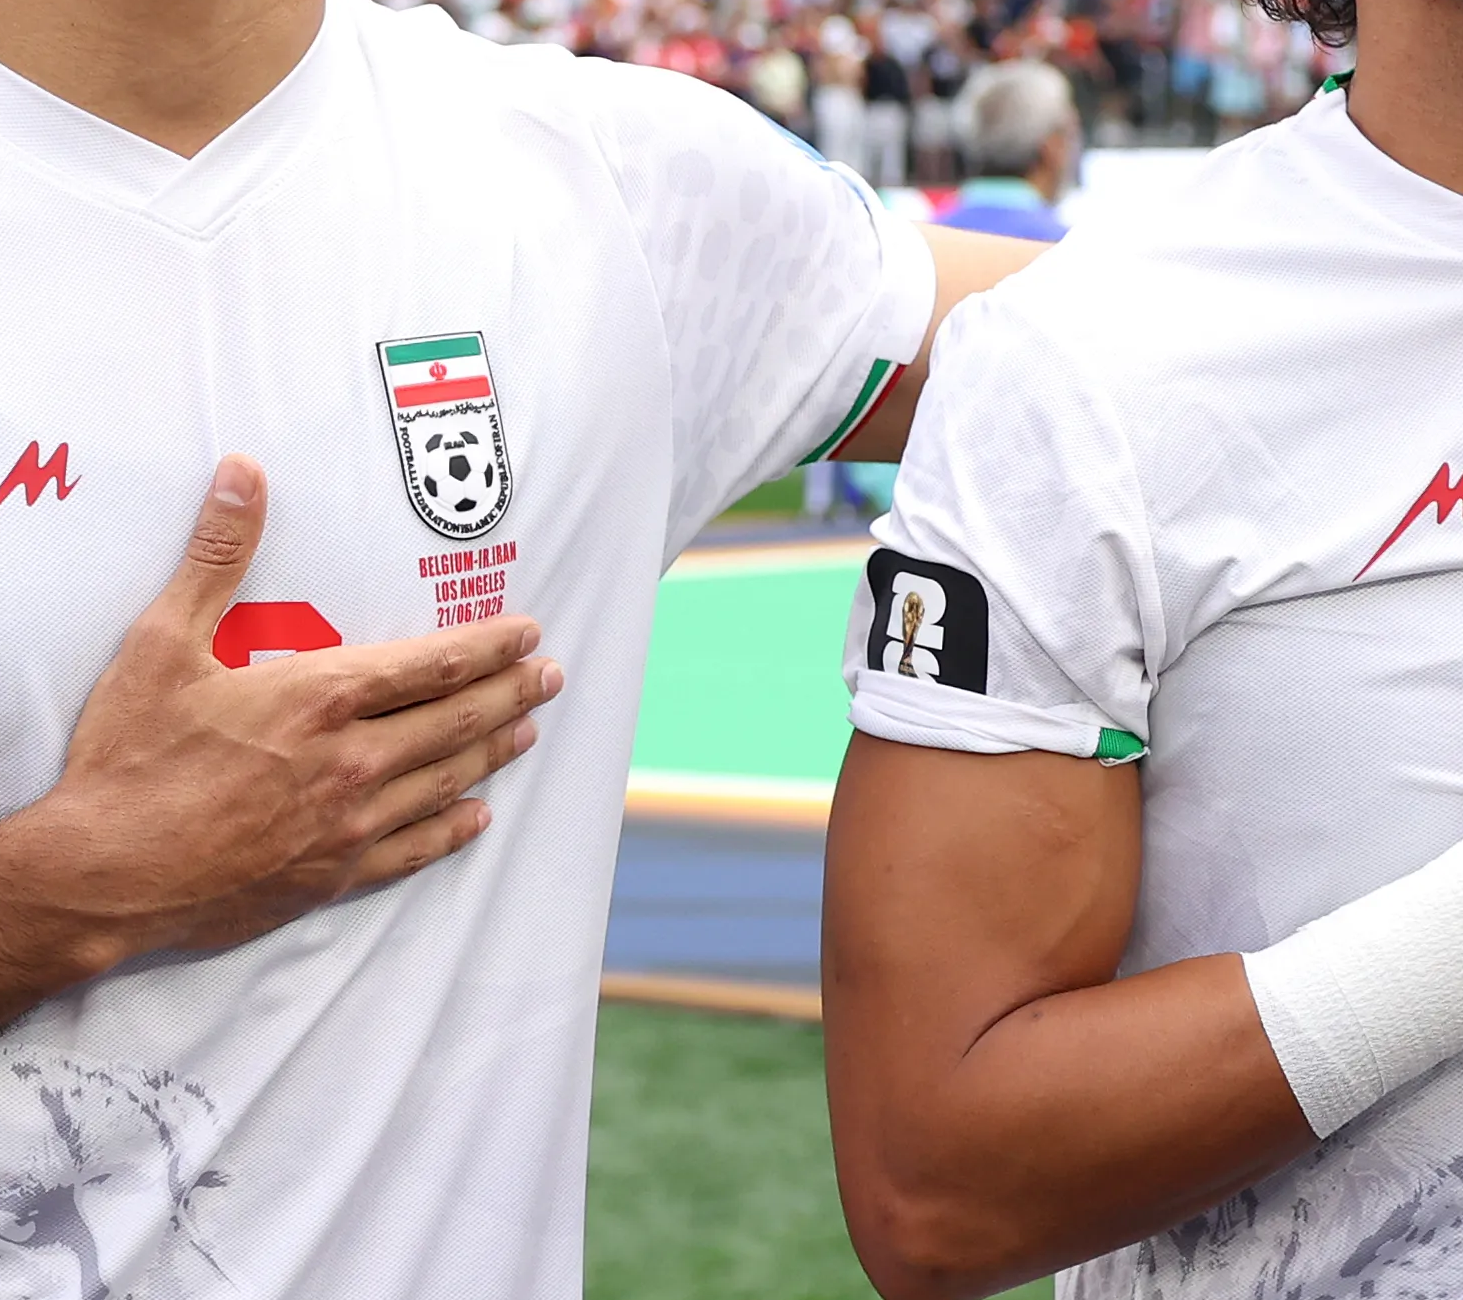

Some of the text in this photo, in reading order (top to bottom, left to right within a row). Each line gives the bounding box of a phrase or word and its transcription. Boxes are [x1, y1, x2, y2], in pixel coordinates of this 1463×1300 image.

[419, 541, 517, 578] BELGIUM-IR.IRAN
[435, 570, 506, 603] LOS ANGELES
[437, 595, 504, 628] 21/06/2026
